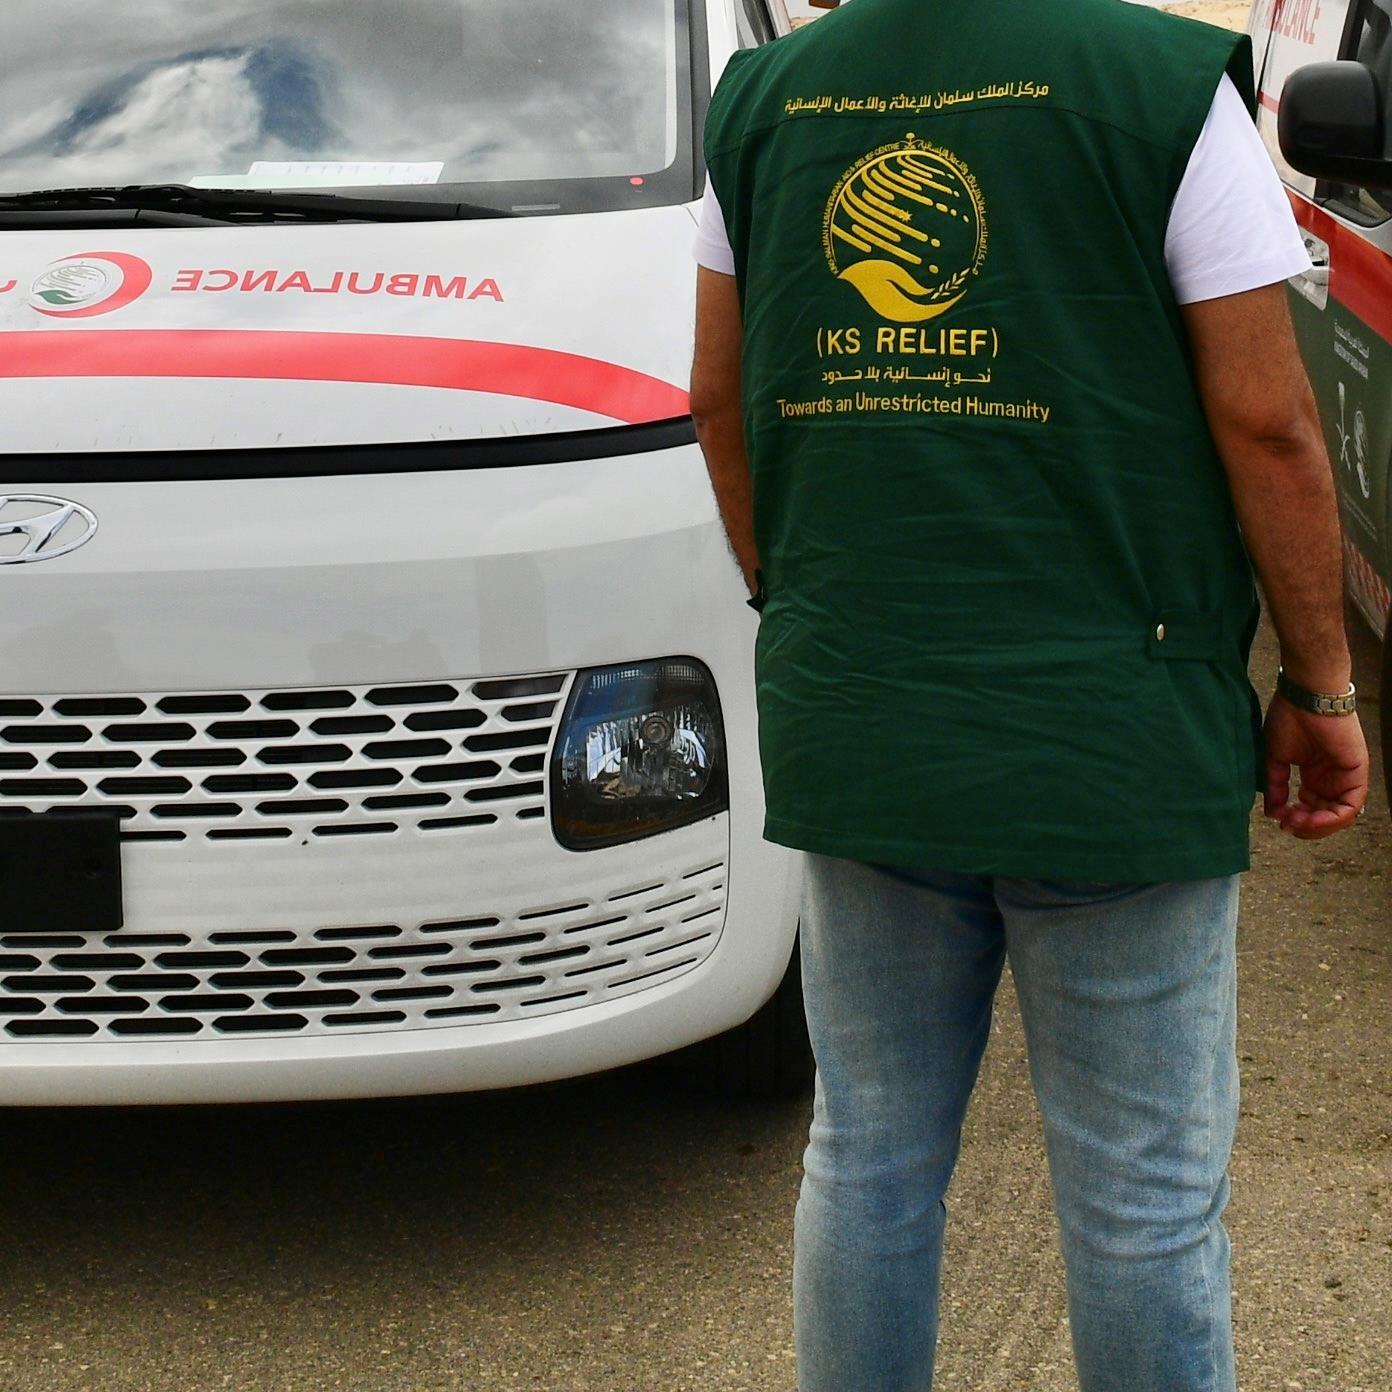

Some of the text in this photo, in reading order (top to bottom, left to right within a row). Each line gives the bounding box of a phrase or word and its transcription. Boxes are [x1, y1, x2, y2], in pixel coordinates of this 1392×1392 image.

[977, 82, 1015, 100] الملك
[1013, 81, 1049, 98] مركز
[934, 89, 975, 109] سلمان
[821, 369, 863, 385] حدود
[953, 368, 991, 385] نحو
[777, 391, 1050, 423] Towards an Unrestricted Humanity
